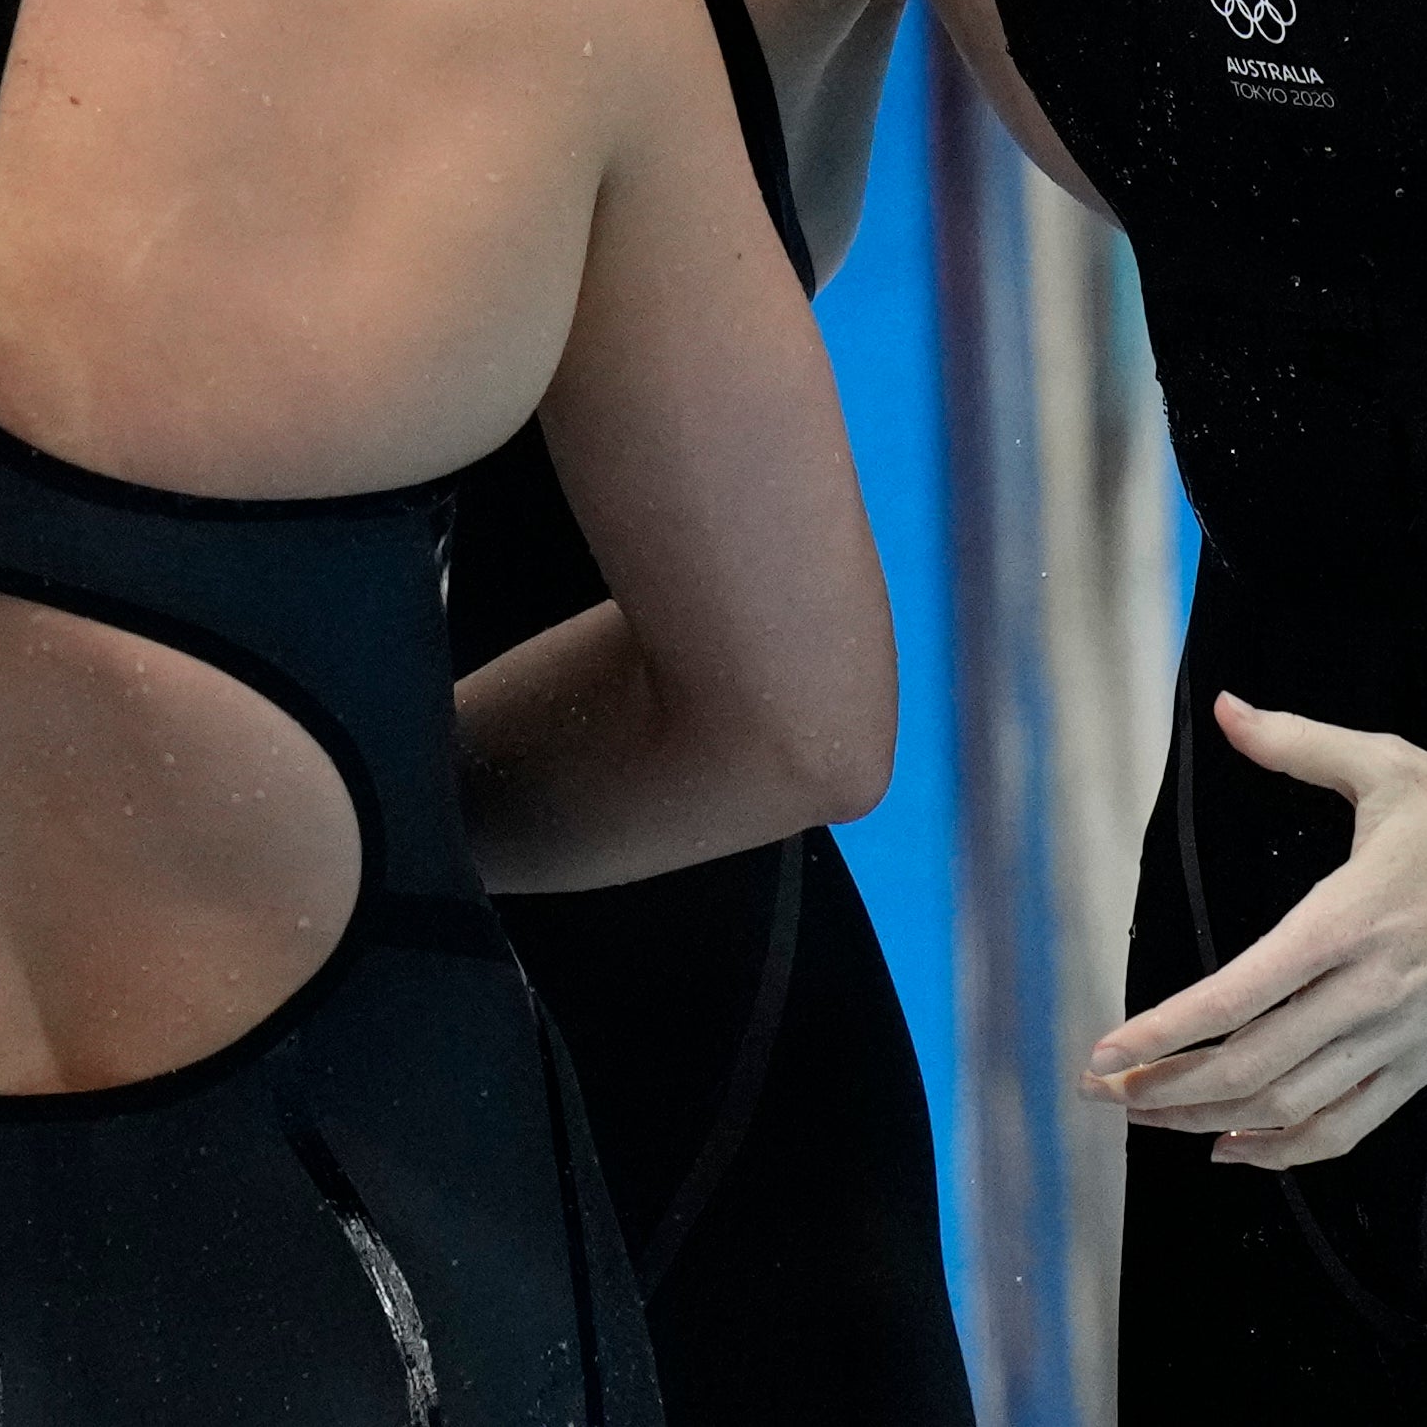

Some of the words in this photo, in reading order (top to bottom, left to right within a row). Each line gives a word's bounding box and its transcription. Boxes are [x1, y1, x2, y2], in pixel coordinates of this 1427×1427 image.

[1226, 56, 1324, 85] AUSTRALIA
[1230, 80, 1288, 103] TOKYO
[1290, 89, 1335, 108] 2020
